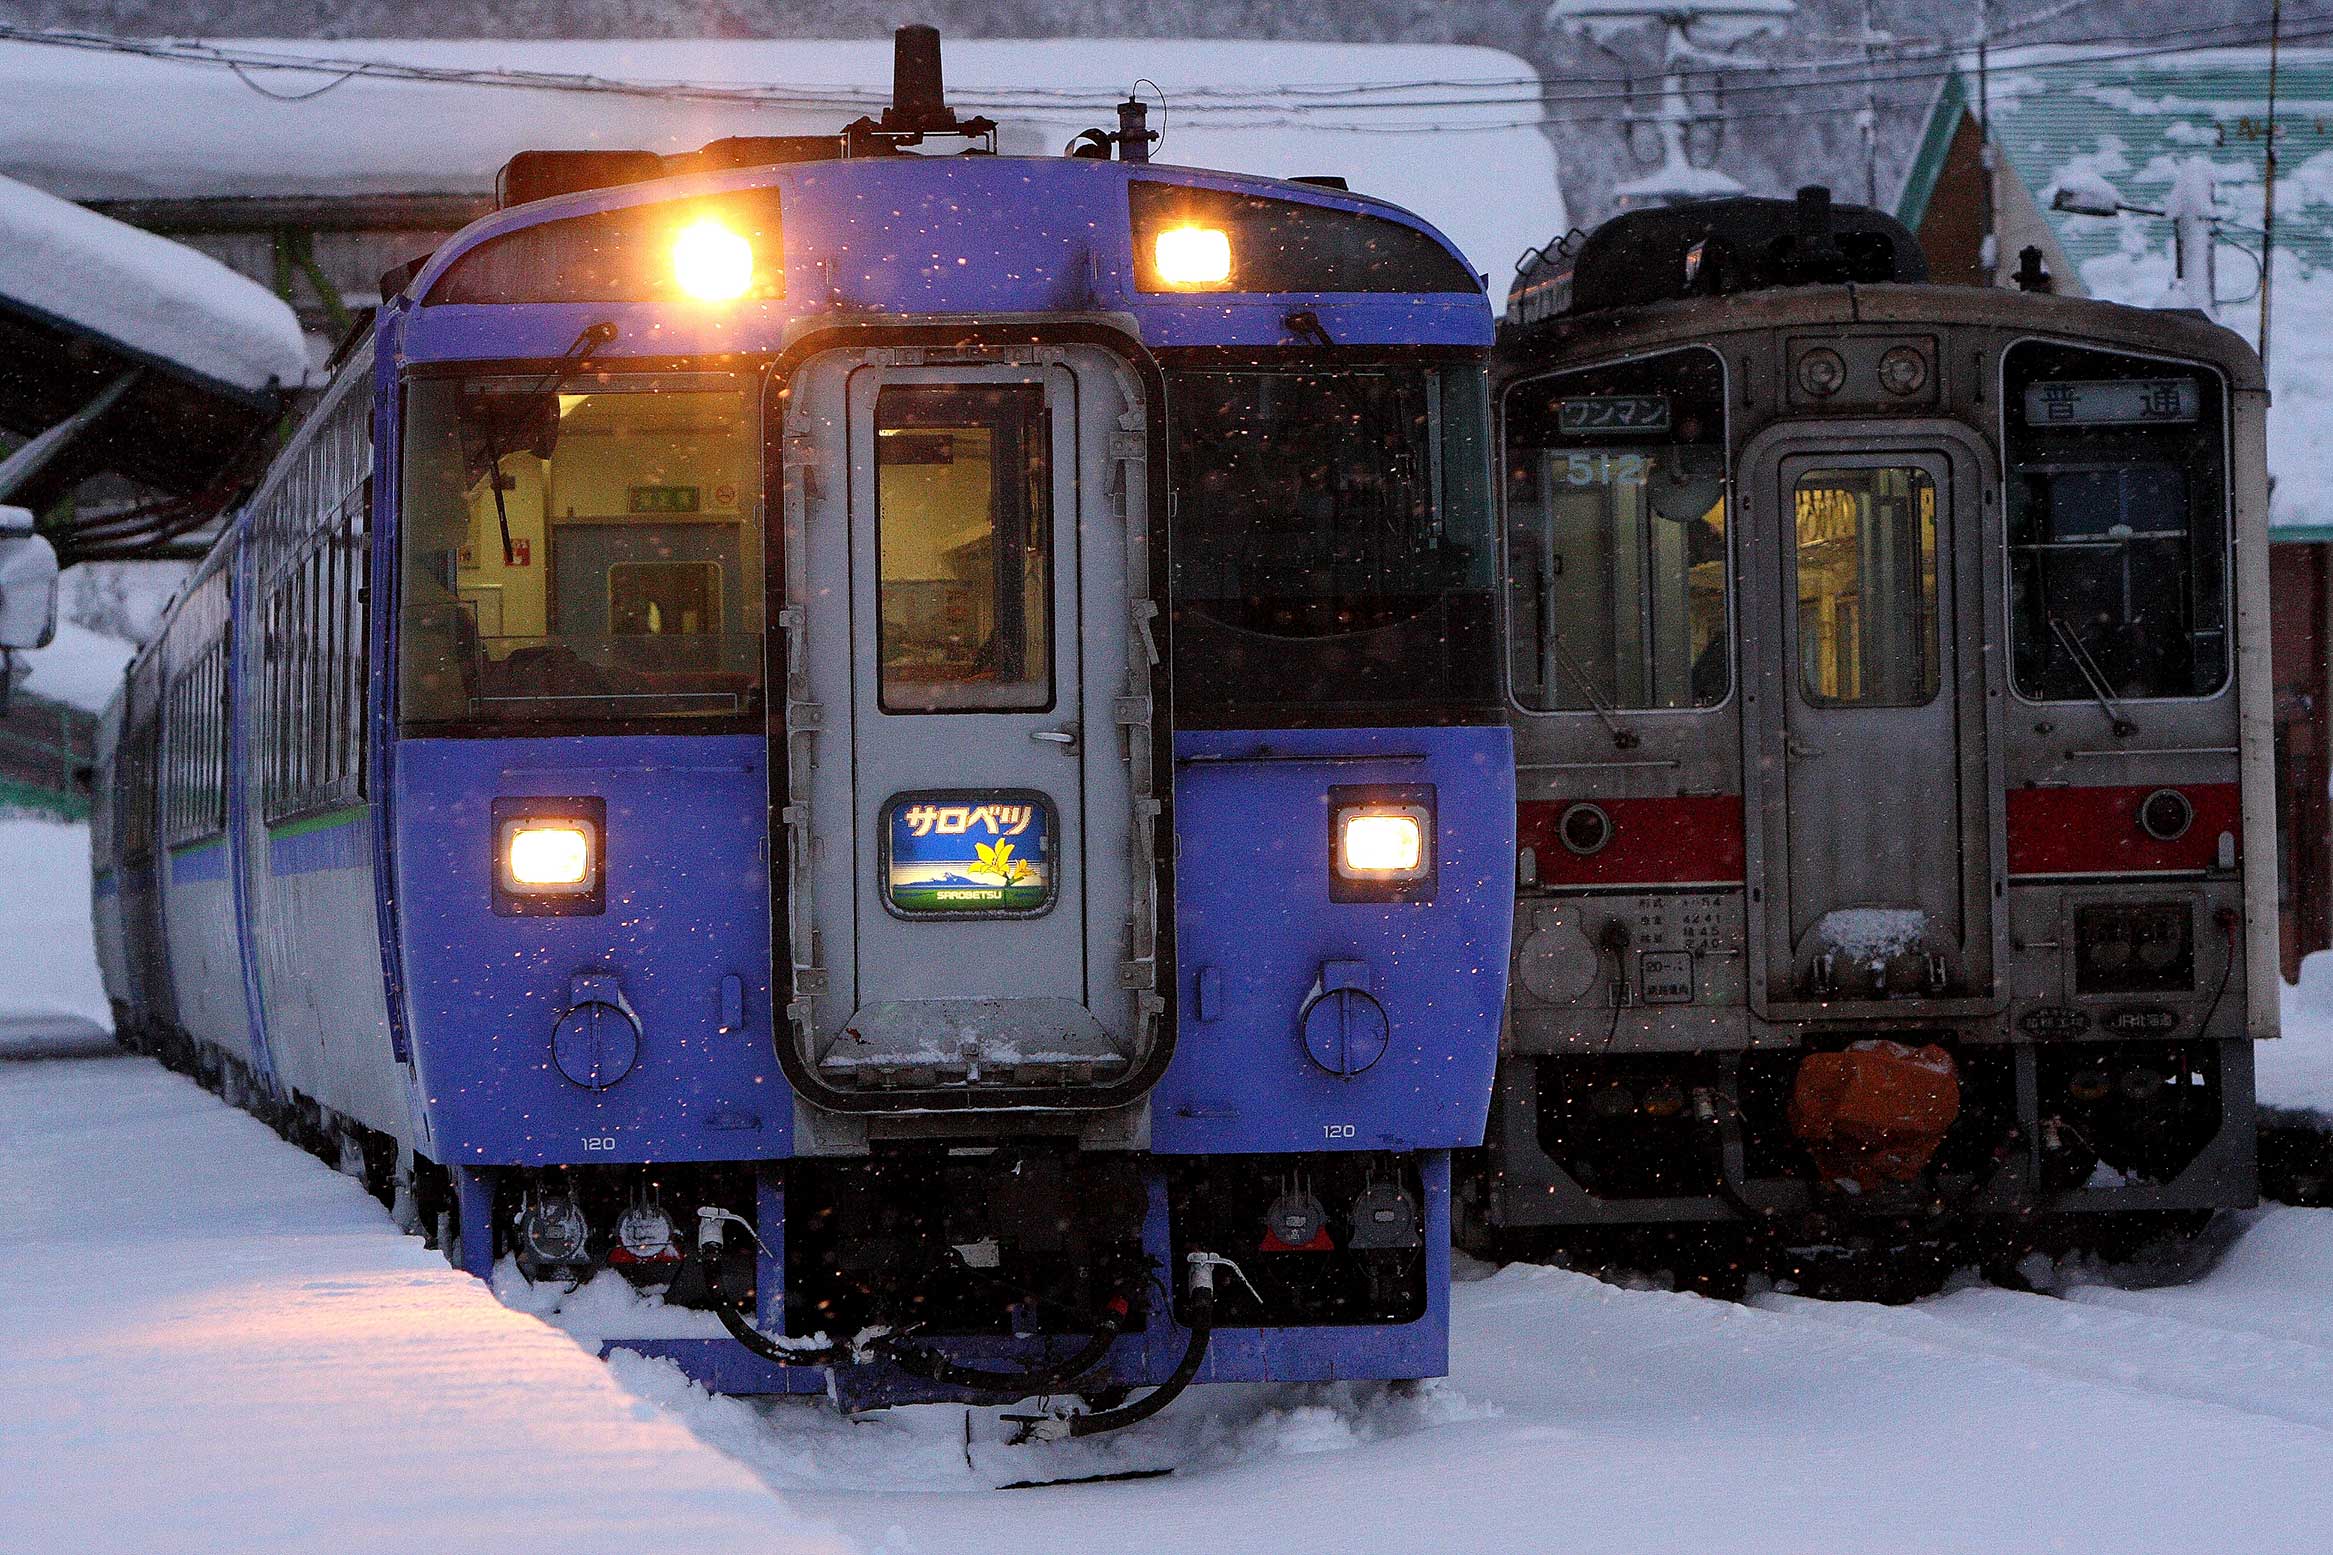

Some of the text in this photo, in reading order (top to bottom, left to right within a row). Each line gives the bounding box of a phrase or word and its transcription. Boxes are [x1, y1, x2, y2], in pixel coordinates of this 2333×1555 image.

[1564, 400, 1665, 425] ワンマン
[1567, 453, 1648, 486] 512
[905, 804, 1032, 837] サロベツ
[936, 890, 1002, 900] SAROBETSU
[1323, 1125, 1355, 1138] 120
[581, 1137, 615, 1151] 120
